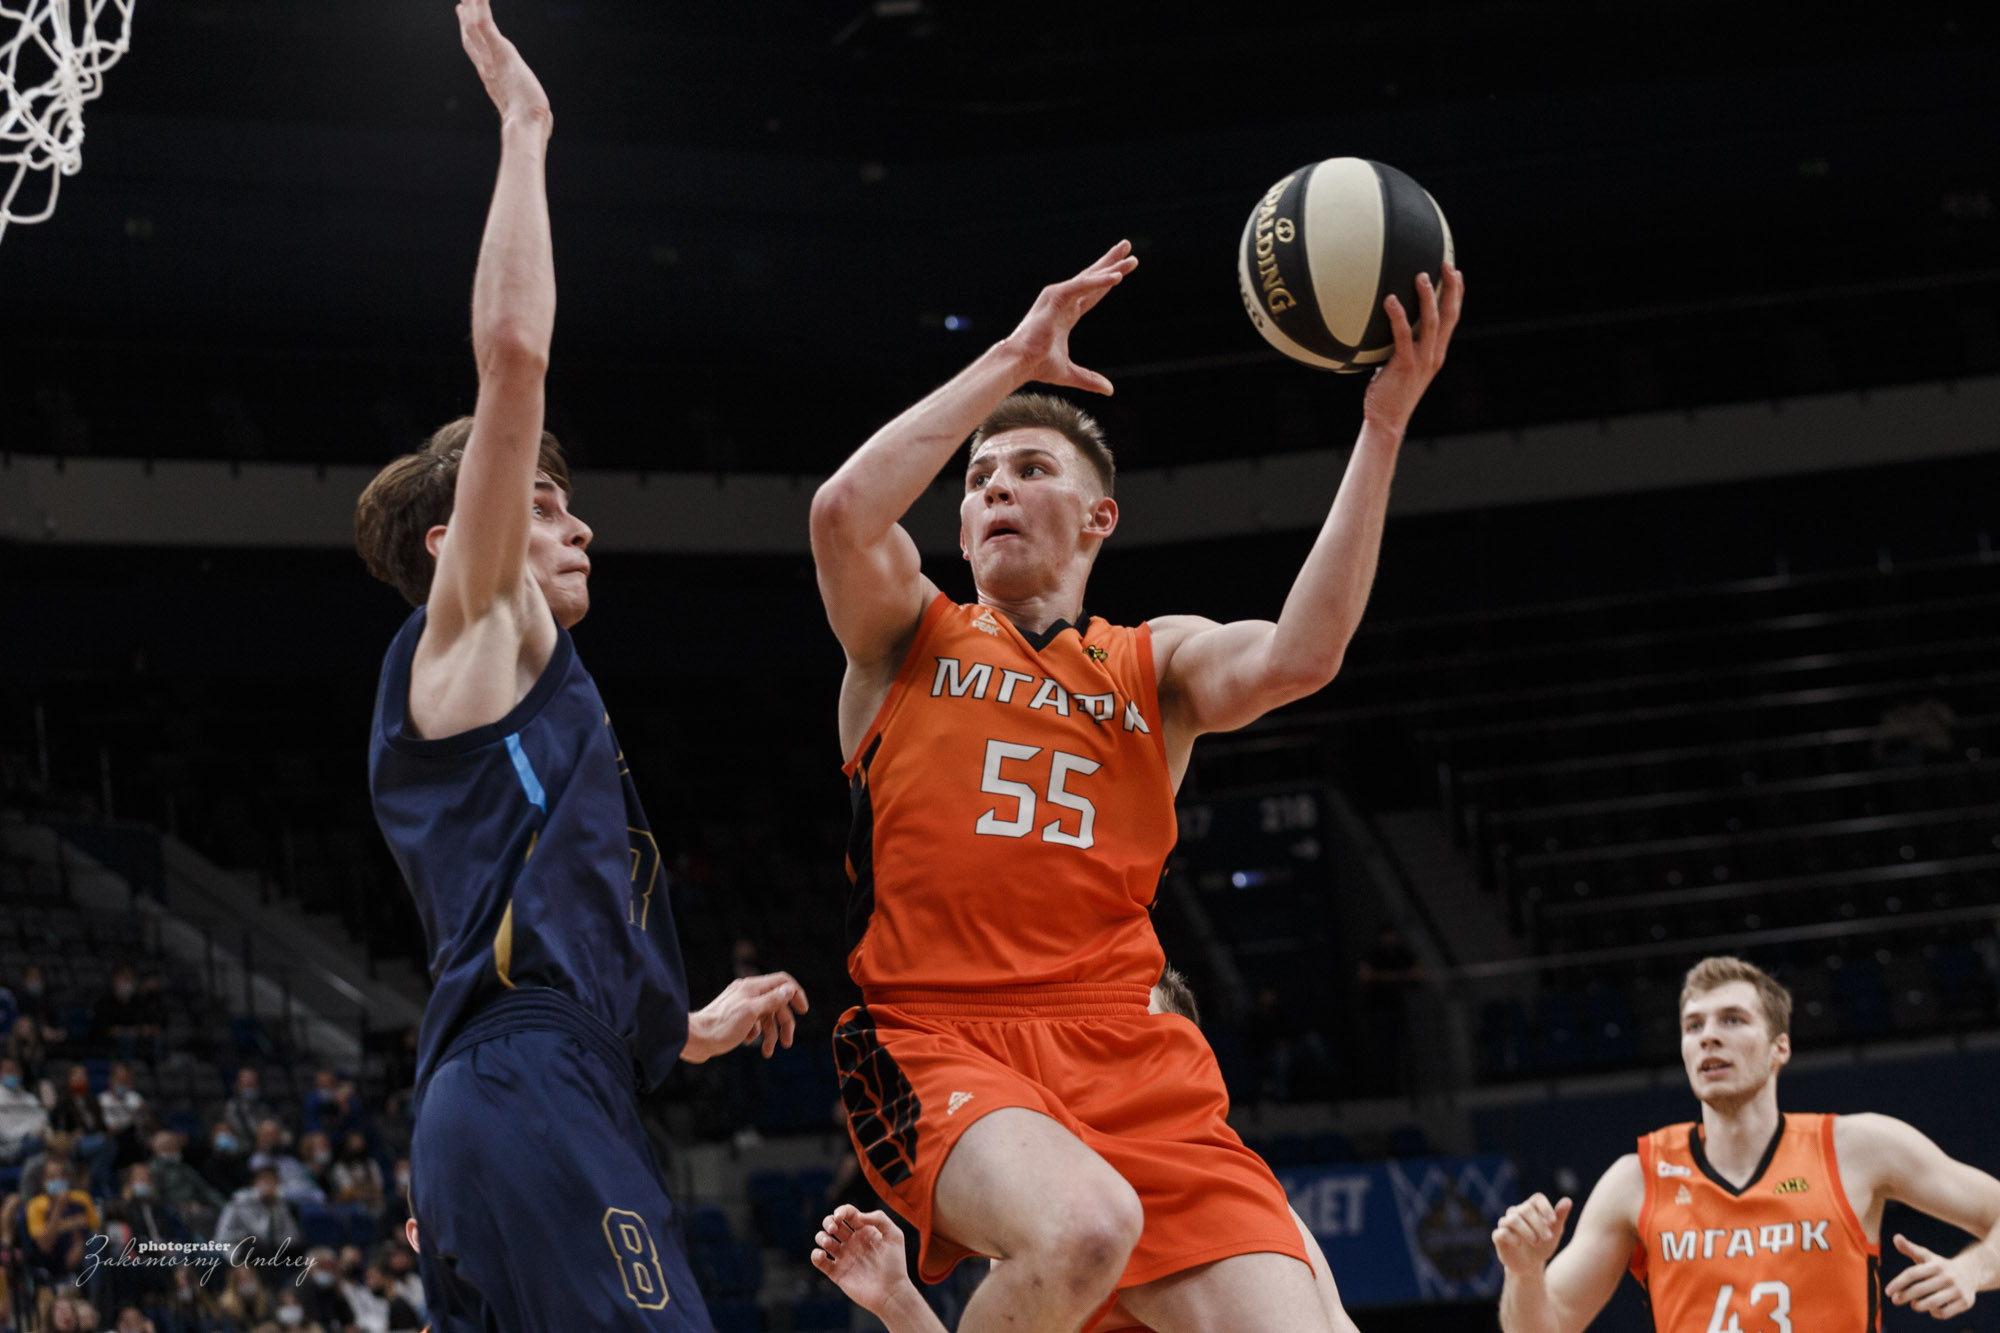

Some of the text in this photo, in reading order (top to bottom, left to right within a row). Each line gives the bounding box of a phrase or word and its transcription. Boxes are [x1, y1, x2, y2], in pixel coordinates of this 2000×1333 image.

[975, 739, 1103, 850] 55
[602, 1206, 669, 1310] 8
[1660, 1220, 1831, 1262] МГАФК
[1706, 1281, 1792, 1333] 43
